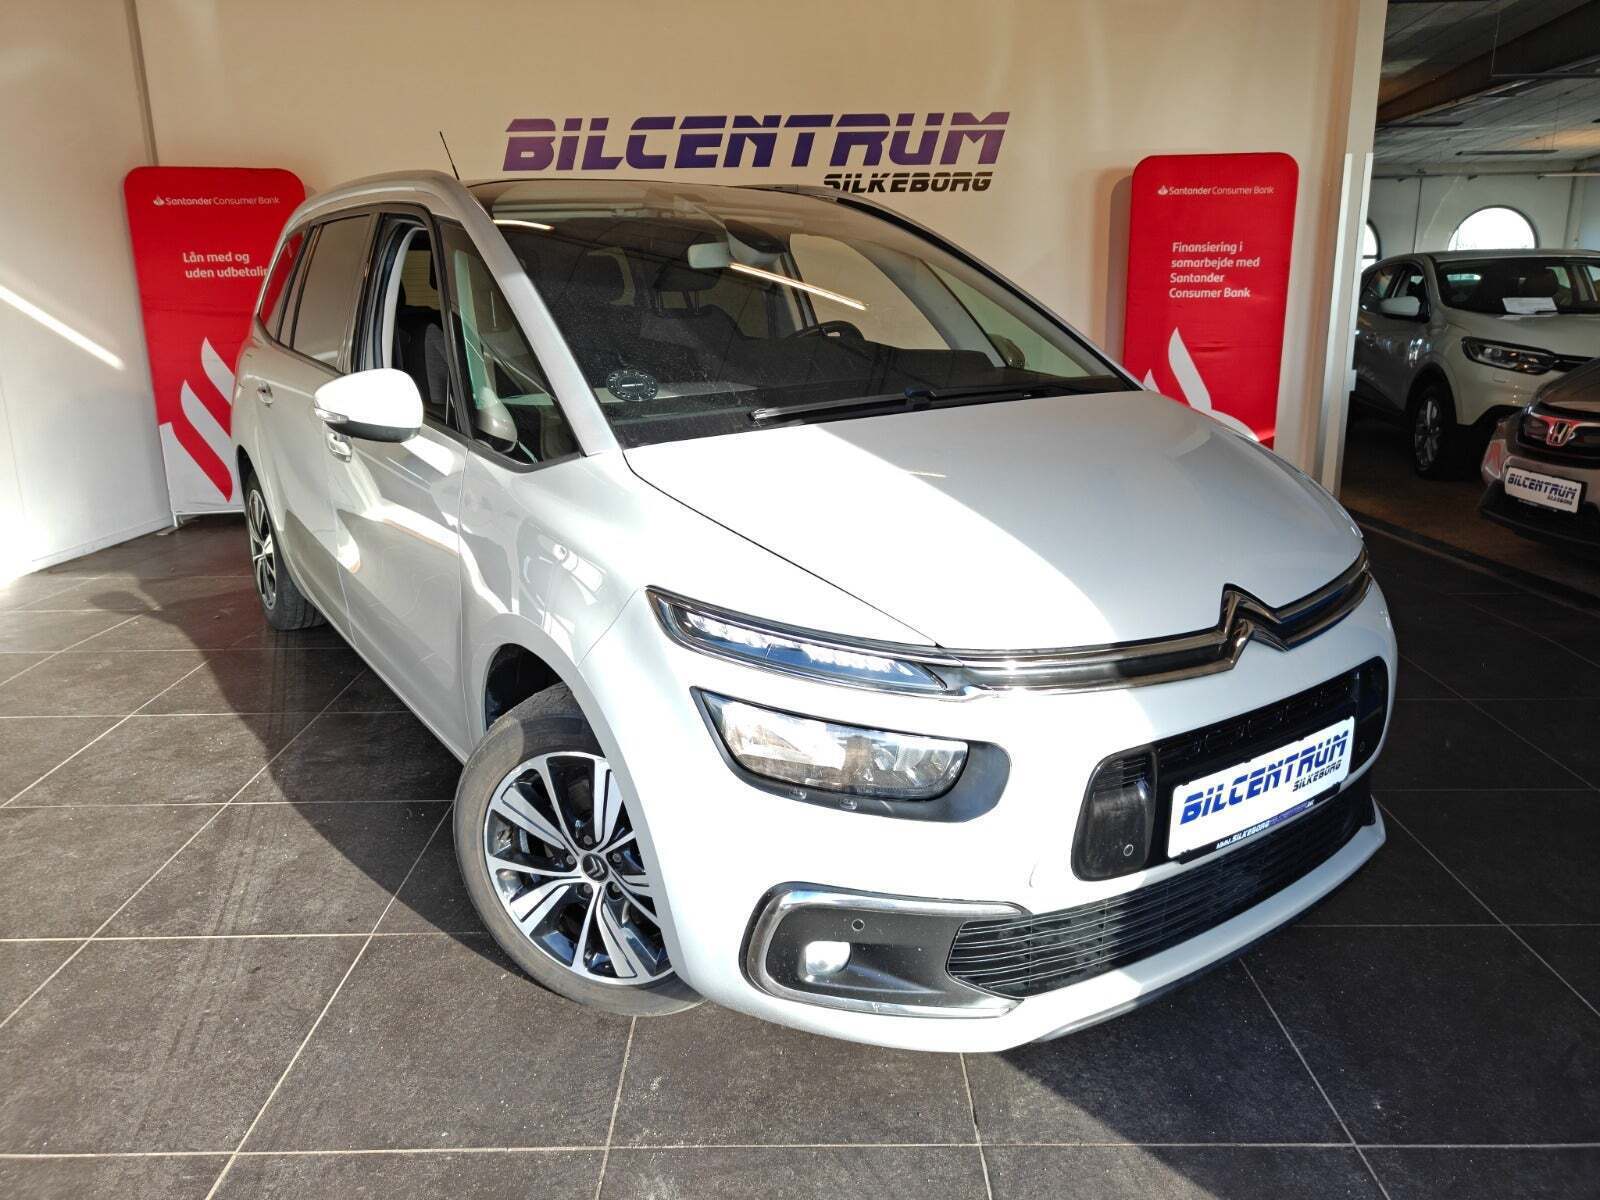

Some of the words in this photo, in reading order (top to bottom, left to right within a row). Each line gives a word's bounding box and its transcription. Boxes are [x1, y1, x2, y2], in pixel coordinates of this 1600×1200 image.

[502, 112, 1010, 171] BILCENTRUM
[824, 172, 993, 193] SILKEBORG
[1168, 186, 1211, 195] Santander
[1212, 186, 1252, 195] Consumer
[1254, 185, 1274, 194] Bank
[165, 197, 212, 206] Santander
[213, 196, 257, 206] Consumer
[258, 196, 280, 205] Bank
[1172, 241, 1237, 254] Finansiering
[1239, 241, 1243, 252] i
[182, 251, 204, 263] Lån
[207, 251, 232, 262] med
[234, 253, 250, 264] og
[1171, 258, 1233, 270] samarbejde
[1235, 257, 1260, 267] med
[185, 268, 214, 278] uden
[1170, 272, 1225, 283] Santander
[1169, 287, 1222, 298] Consumer
[1223, 287, 1250, 298] Bank
[1507, 474, 1577, 499] BILCENTRUM
[1180, 730, 1349, 825] BILCENTRUM
[1292, 759, 1342, 792] SILKEBORG
